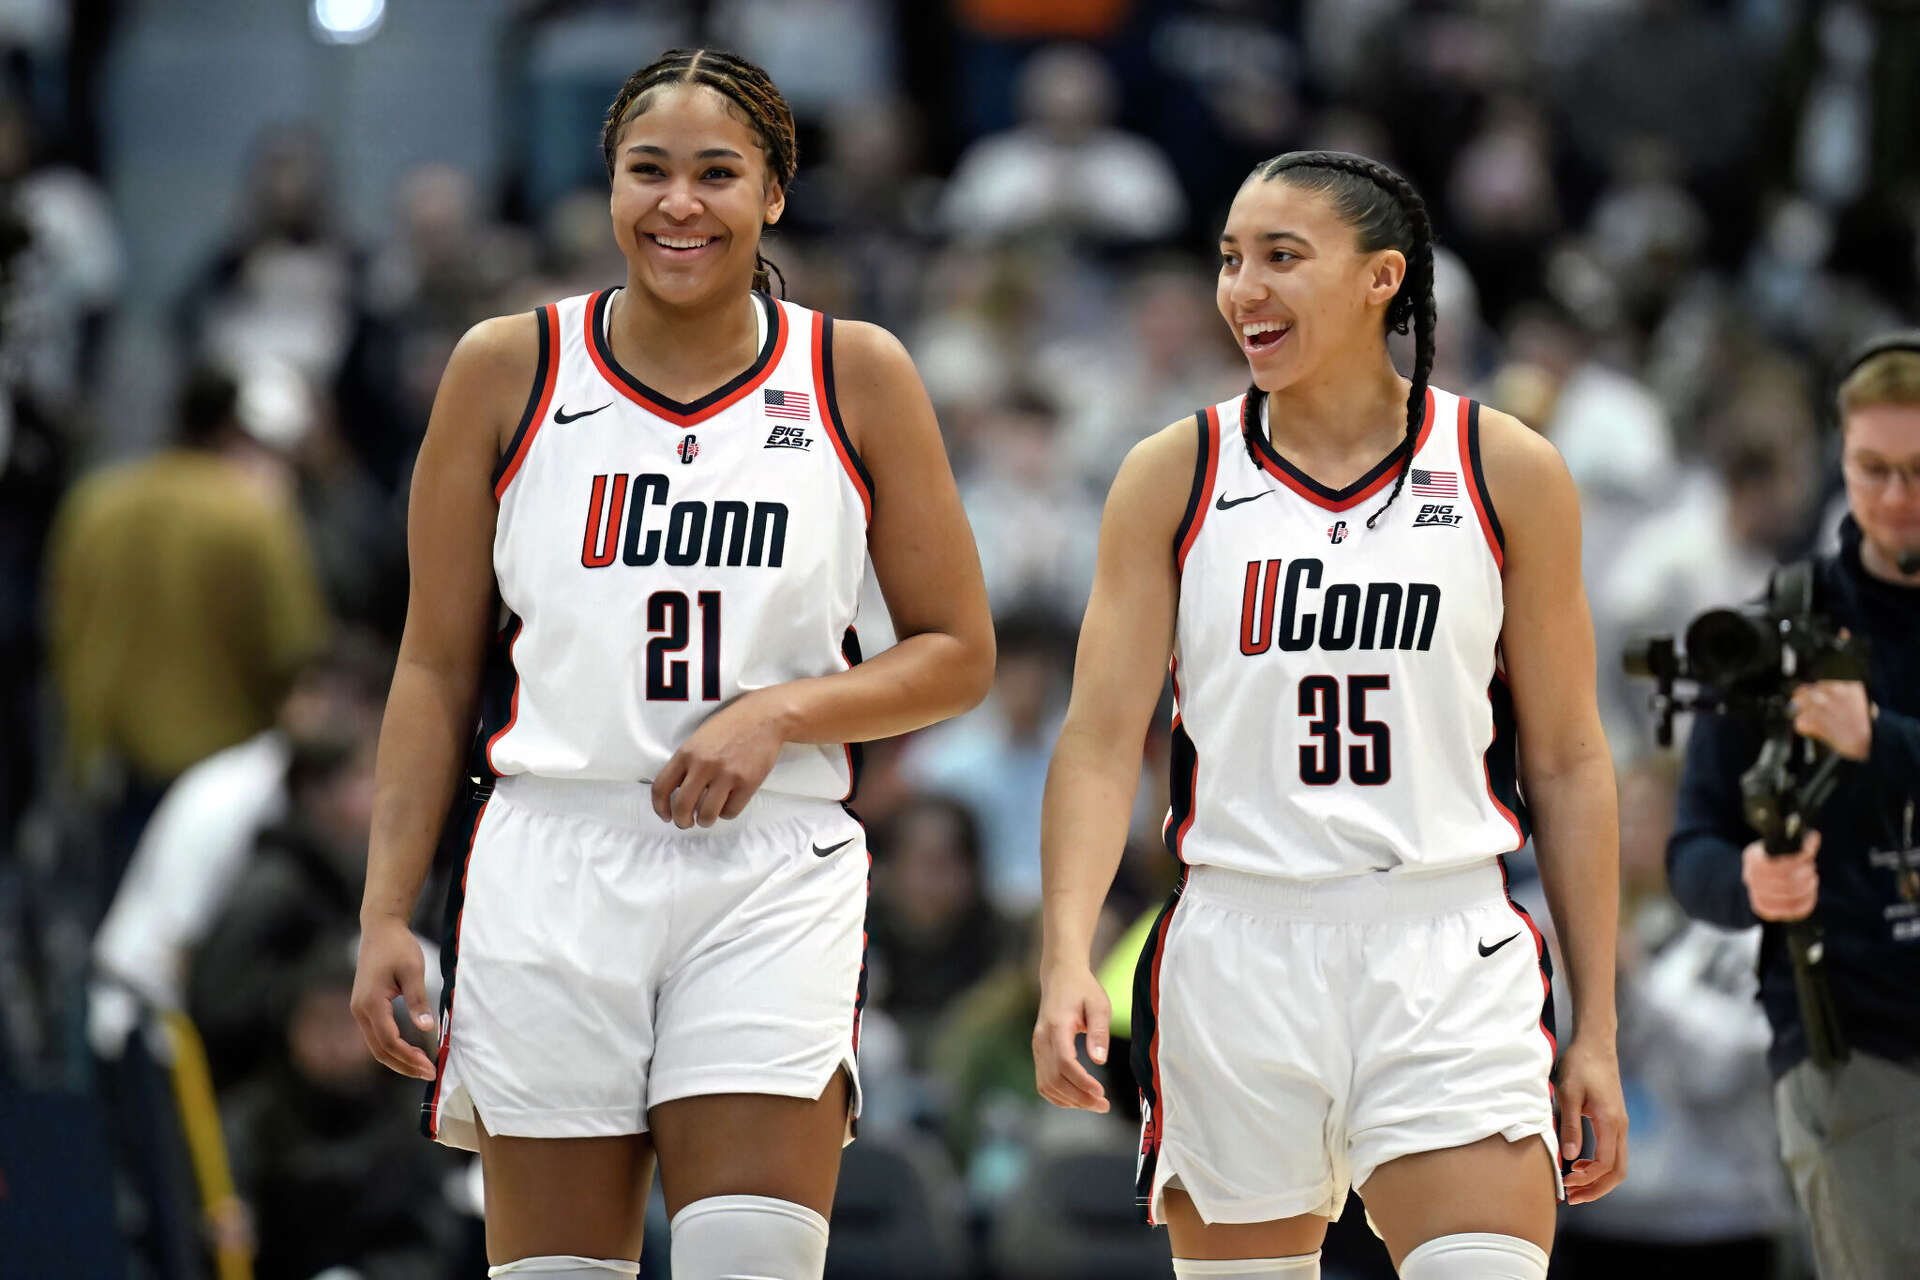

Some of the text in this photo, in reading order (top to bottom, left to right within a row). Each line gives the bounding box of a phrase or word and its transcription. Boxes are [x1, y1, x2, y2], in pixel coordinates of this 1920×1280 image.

[766, 435, 814, 448] EAST
[771, 425, 805, 437] BIG
[581, 473, 789, 569] UConn
[1415, 514, 1463, 524] EAST
[1420, 504, 1454, 514] BIG
[1239, 558, 1441, 657] UConn
[646, 590, 721, 701] 21
[1298, 674, 1391, 786] 35
